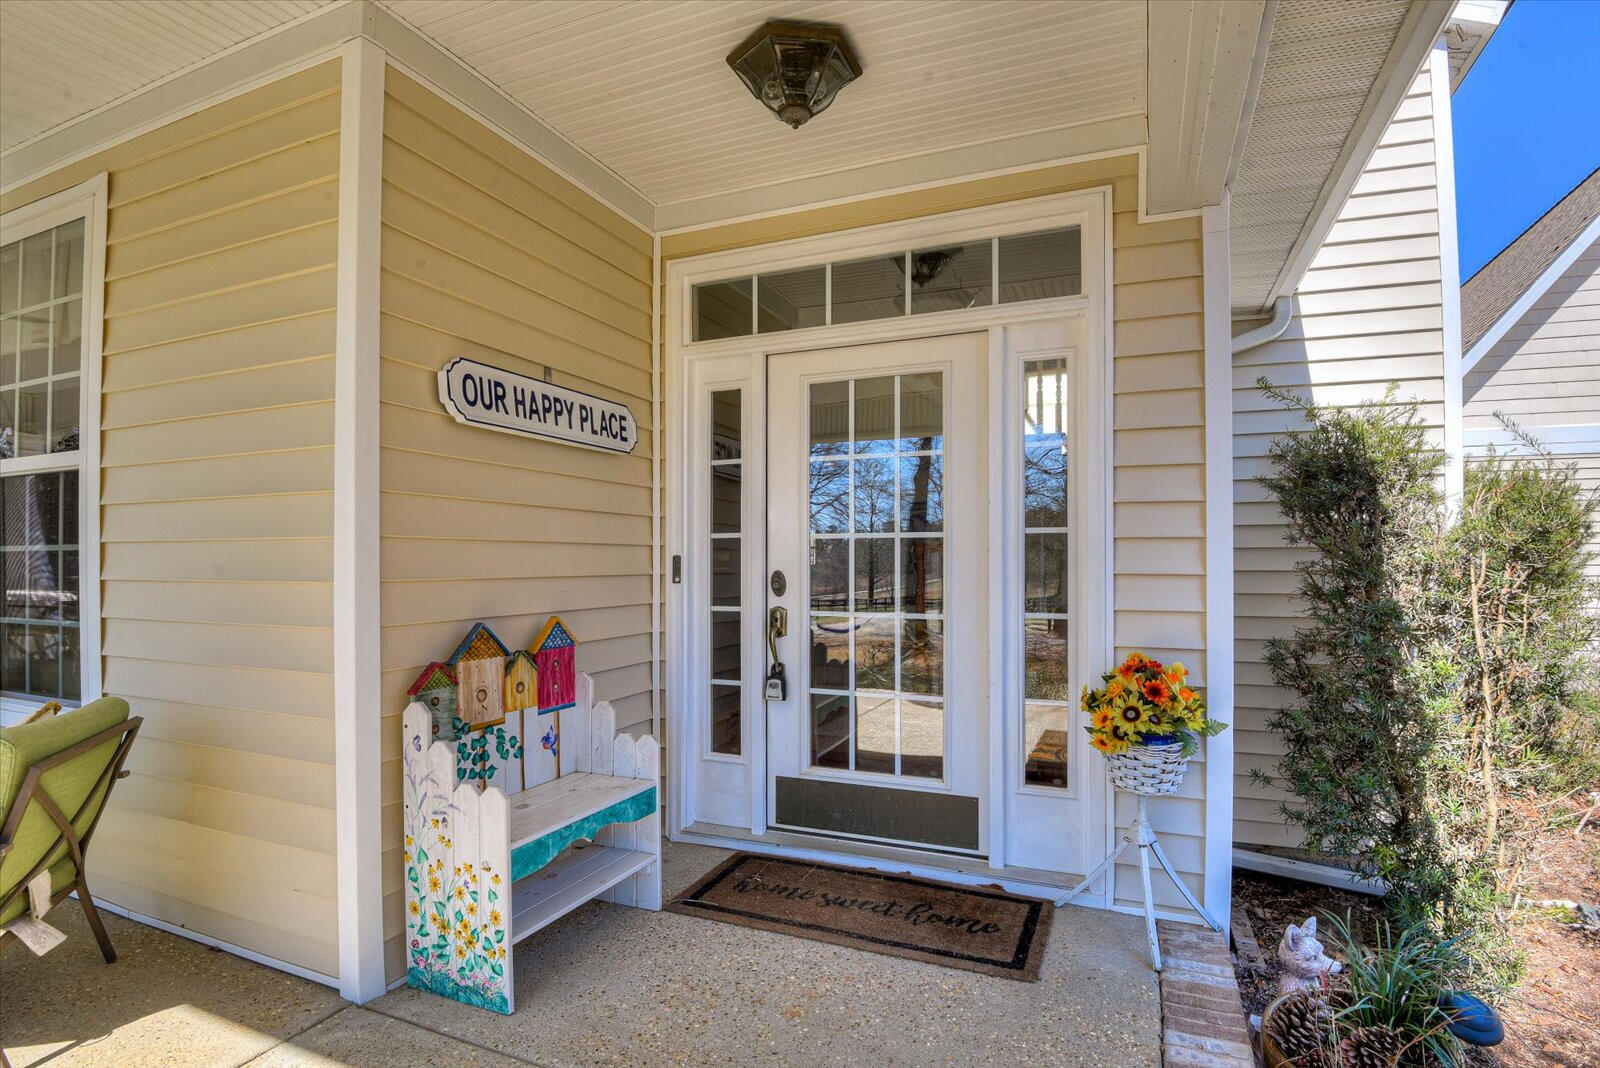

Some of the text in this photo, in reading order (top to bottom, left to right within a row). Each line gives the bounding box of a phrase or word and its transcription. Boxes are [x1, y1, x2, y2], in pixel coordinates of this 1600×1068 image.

[462, 373, 628, 442] OUR HAPPY PLACE
[904, 902, 1001, 934] home
